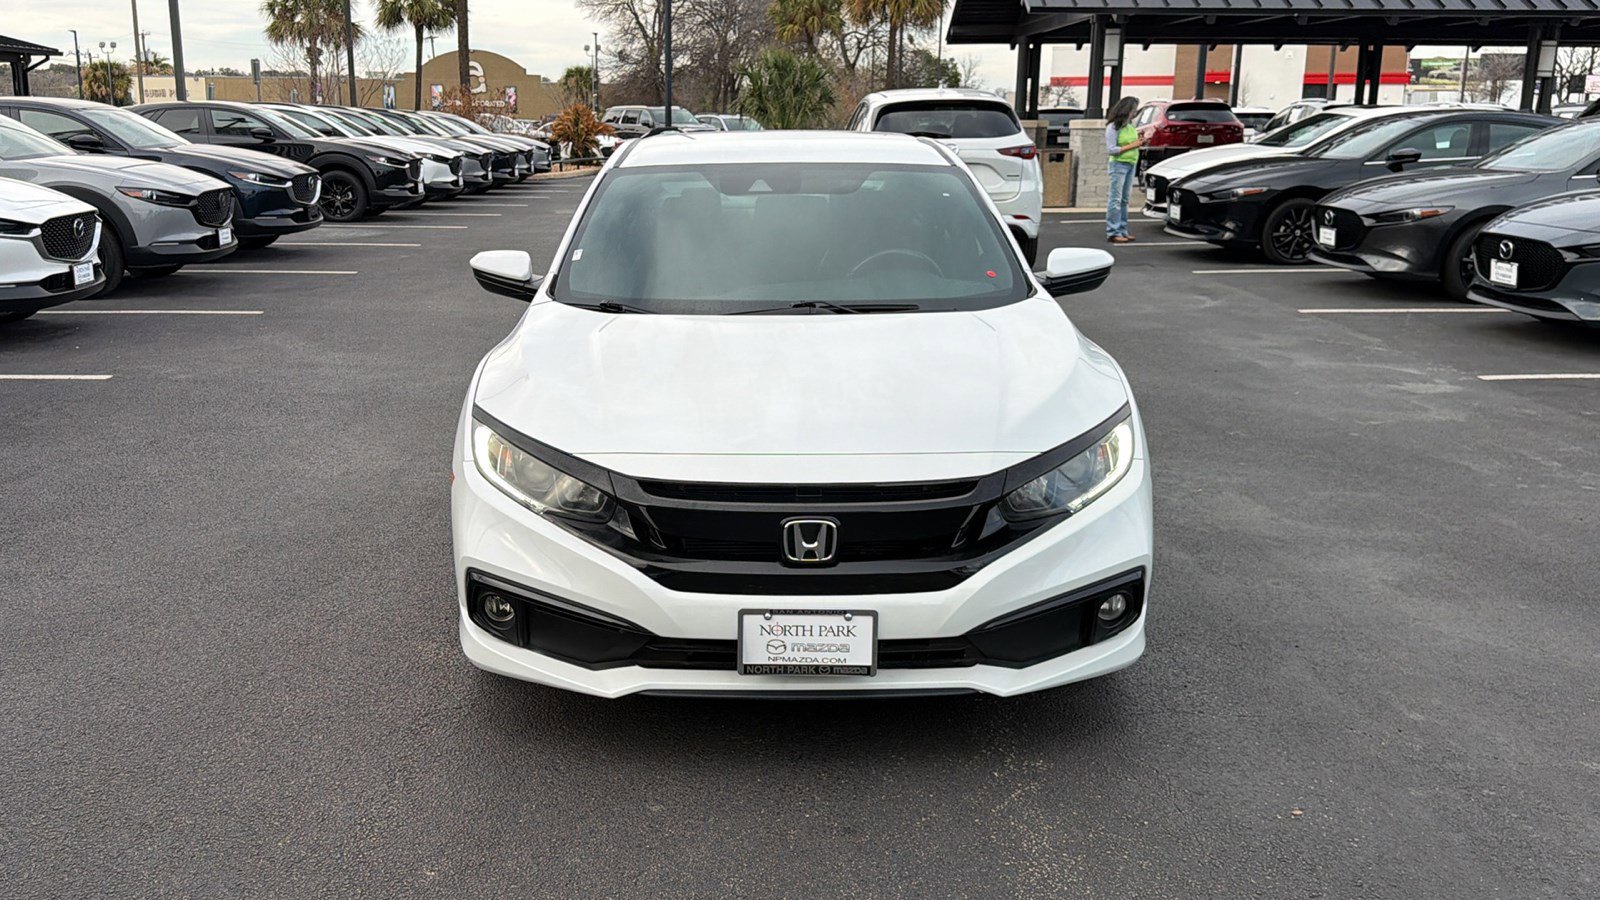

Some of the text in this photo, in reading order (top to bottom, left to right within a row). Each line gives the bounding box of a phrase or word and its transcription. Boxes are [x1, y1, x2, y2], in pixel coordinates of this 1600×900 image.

[759, 624, 857, 637] NORTH PARK
[791, 642, 851, 653] mazda
[767, 656, 847, 664] NPMAZDA.COM
[746, 665, 868, 674] NORTH PARK mazda
